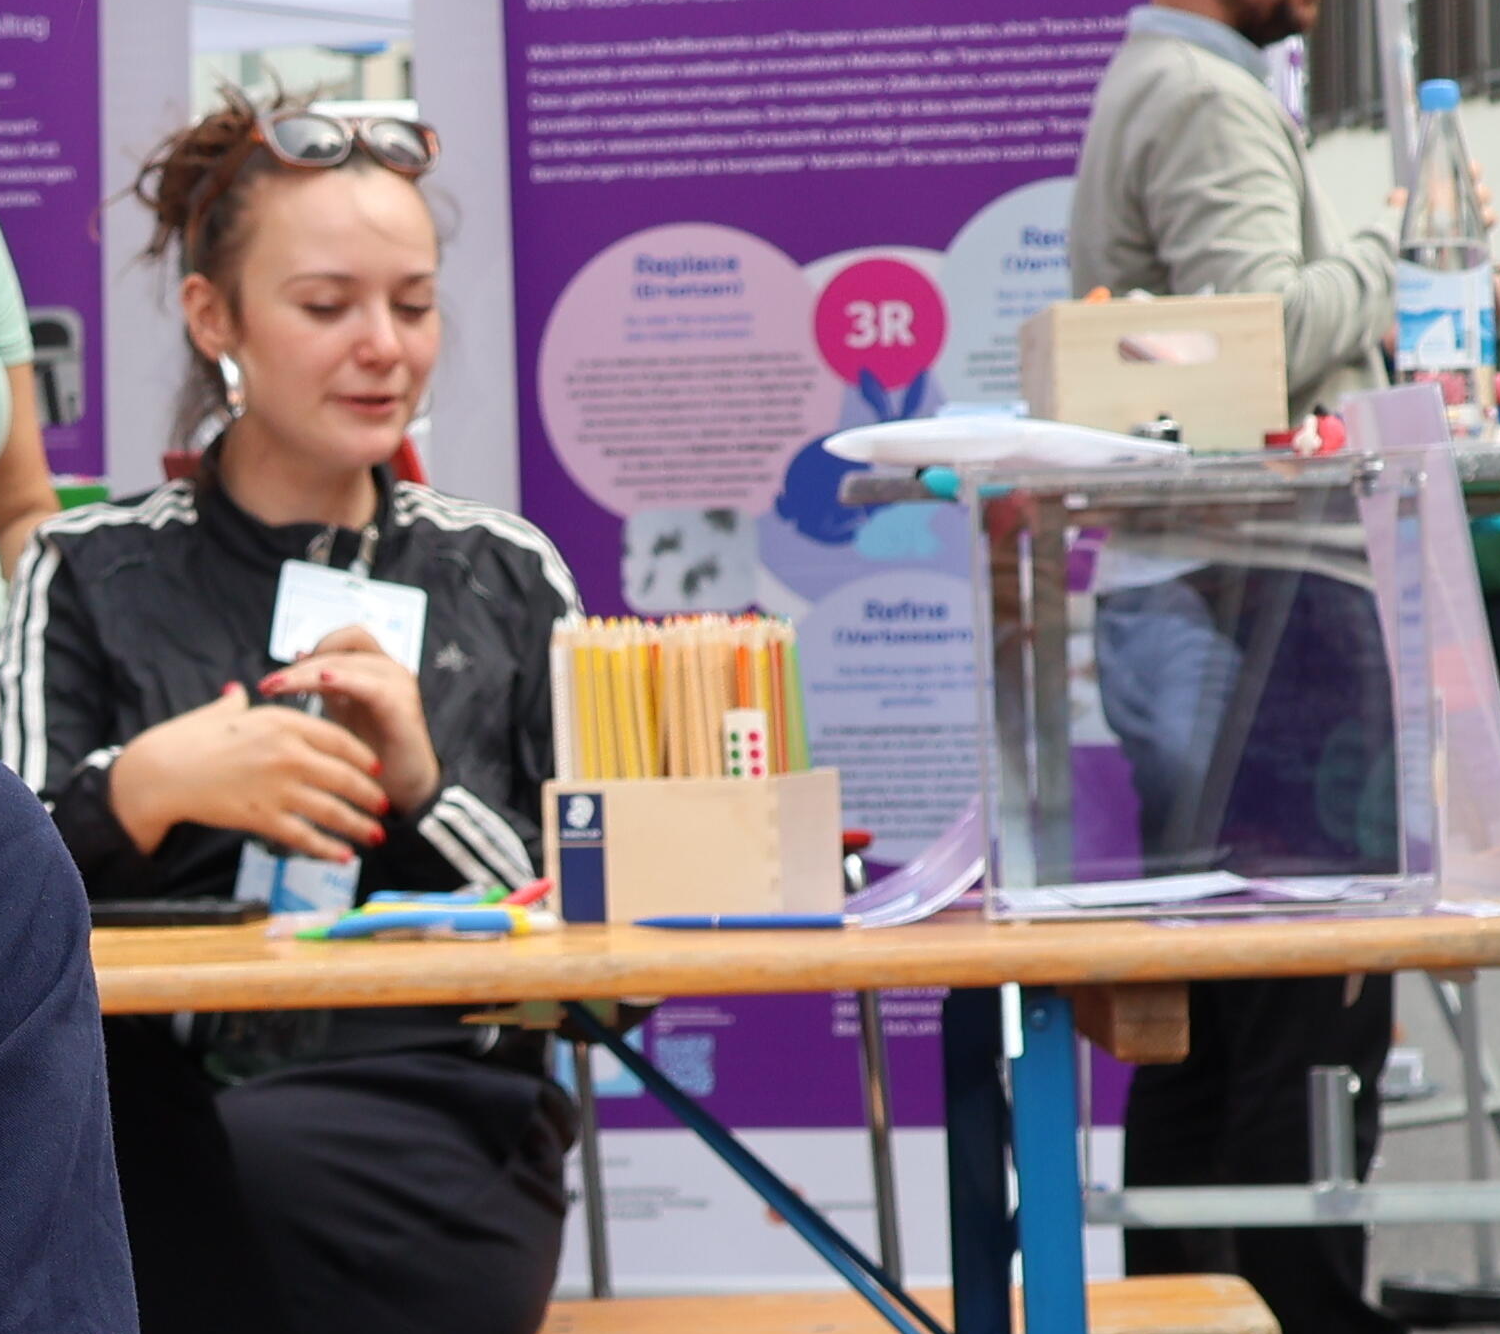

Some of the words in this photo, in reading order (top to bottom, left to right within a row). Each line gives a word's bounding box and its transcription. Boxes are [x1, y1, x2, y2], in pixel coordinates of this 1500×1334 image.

[633, 253, 740, 277] Replace
[844, 300, 916, 348] 3R
[864, 599, 949, 621] Refine
